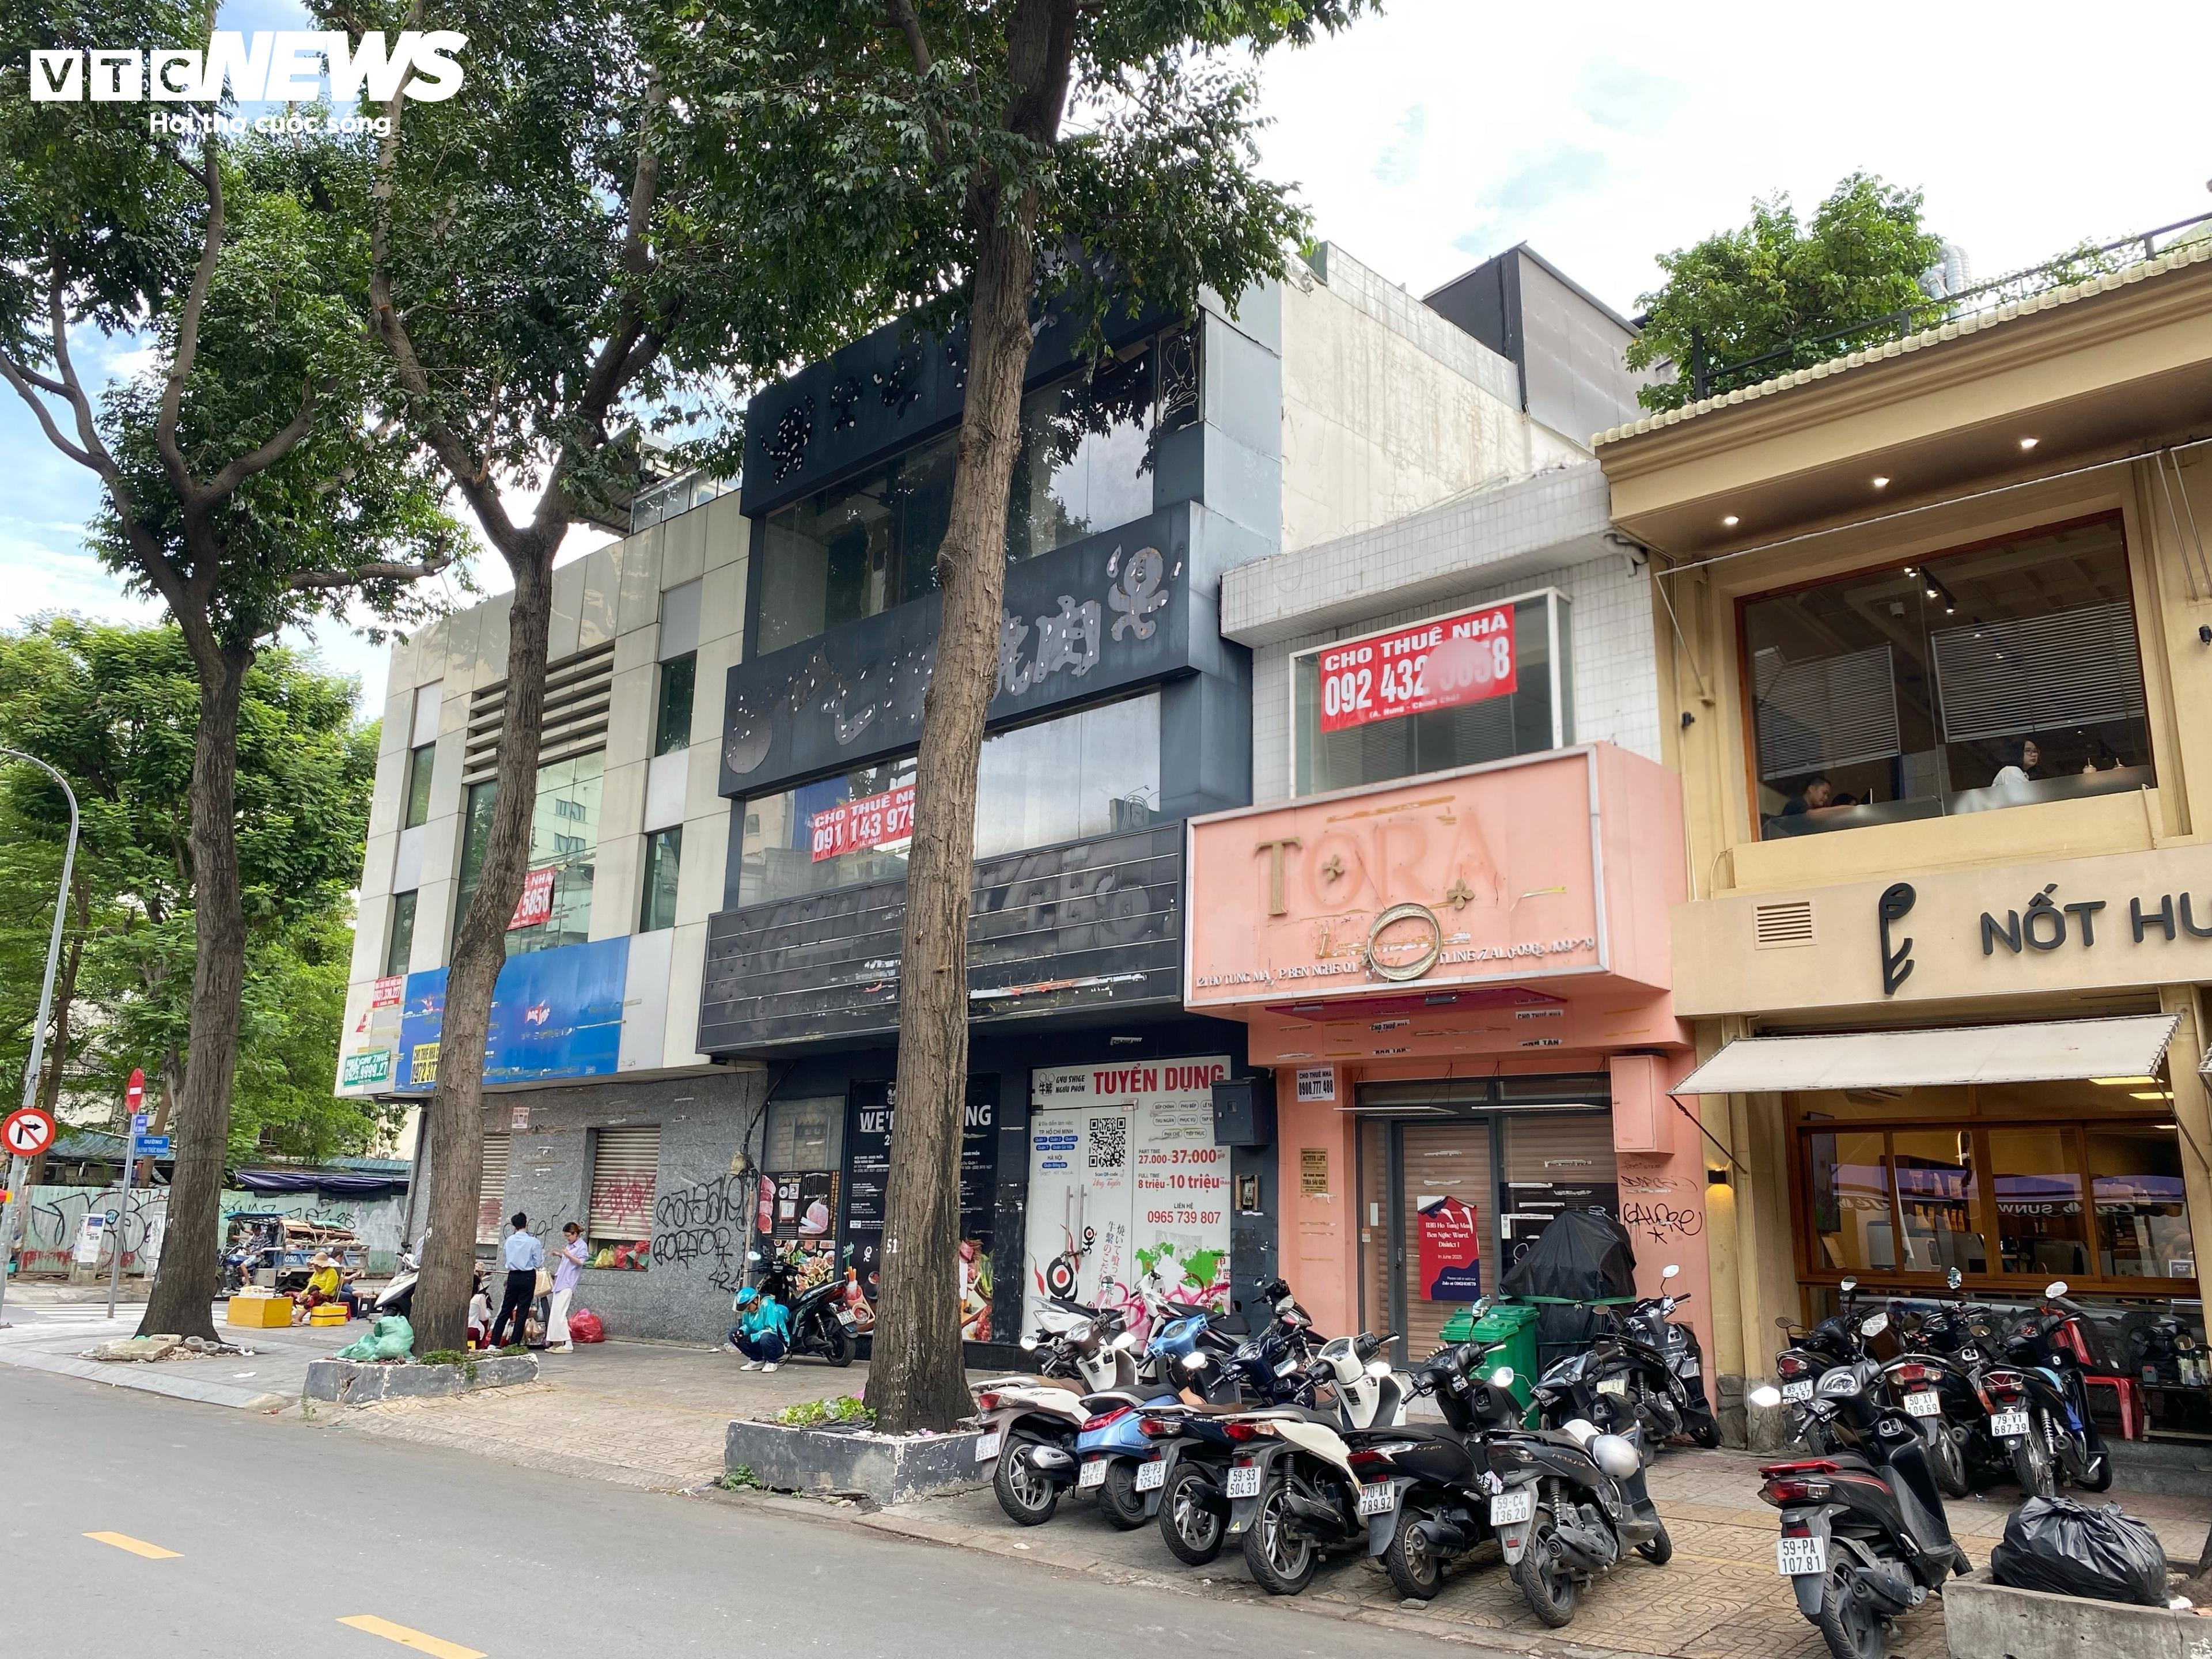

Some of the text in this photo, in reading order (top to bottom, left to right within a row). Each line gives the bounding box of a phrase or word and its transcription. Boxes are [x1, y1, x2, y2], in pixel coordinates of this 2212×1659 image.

[1325, 611, 1508, 671] CHO THUÊ NHÀ
[1325, 669, 1372, 716] 092
[1381, 655, 1429, 703] 432
[815, 789, 915, 827] CHO THUÊ NH
[814, 823, 842, 853] 091
[850, 813, 881, 842] 143
[531, 870, 554, 887] NHÀ
[521, 886, 550, 916] 5858
[1980, 884, 2107, 955] NỐT
[1224, 974, 1250, 985] TUNG
[1288, 966, 1309, 979] BEN
[373, 1051, 389, 1062] THUÊ
[1056, 1074, 1085, 1084] GYU SHIGE
[1093, 1063, 1224, 1094] TUYỂN DỤNG
[1309, 1070, 1321, 1078] THUÊ
[1323, 1069, 1332, 1077] NHÀ
[859, 1111, 894, 1130] WE'
[1138, 1174, 1219, 1193] 8 triệu 10 triệu
[1147, 1211, 1221, 1224] 0965 739 807
[1909, 1394, 1931, 1406] 50-X1
[1995, 1423, 2027, 1434] 687.39
[1142, 1463, 1161, 1476] 59-P3
[1233, 1469, 1256, 1482] 59-S3
[1230, 1482, 1256, 1495] 504.31
[1365, 1484, 1388, 1499] 70-AA
[1362, 1497, 1391, 1513] 789.92
[1497, 1495, 1524, 1509] 59-C4
[1495, 1507, 1527, 1524] 136.20
[1783, 1540, 1816, 1556] 59-PA
[1782, 1555, 1821, 1574] 107.81
